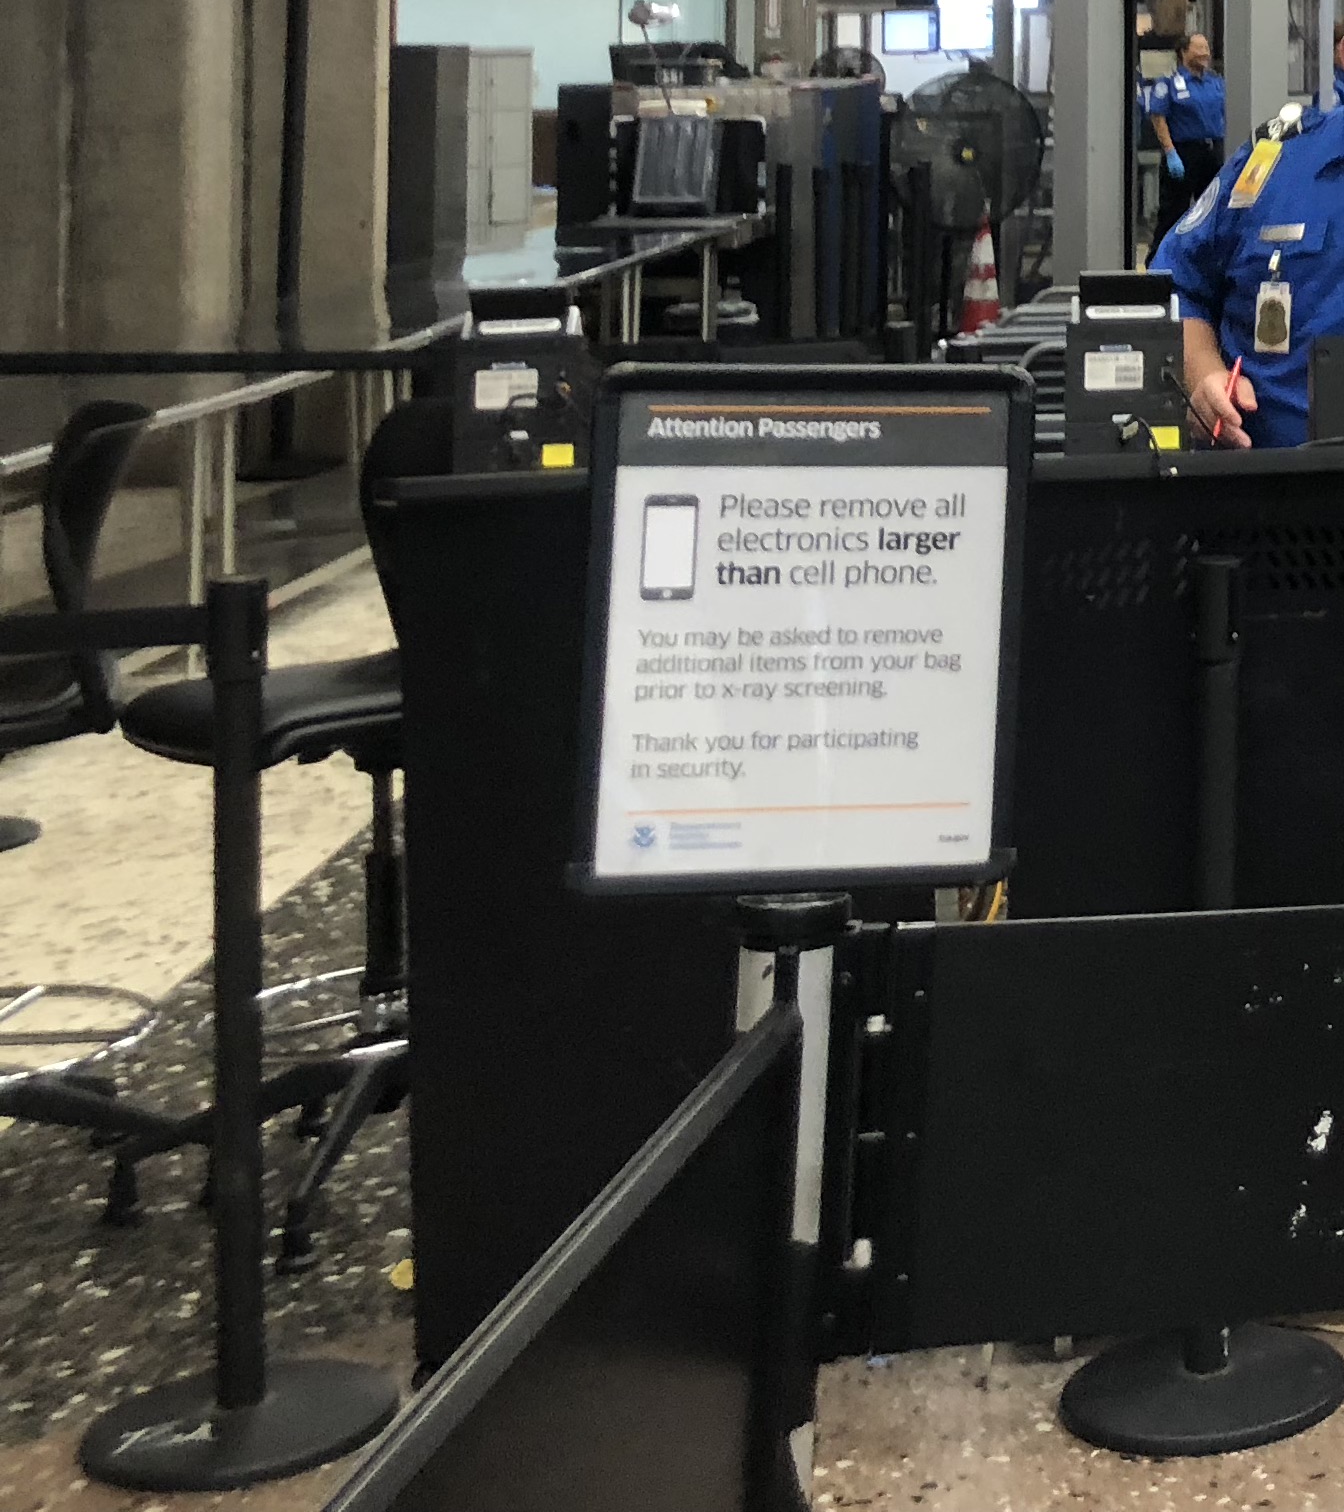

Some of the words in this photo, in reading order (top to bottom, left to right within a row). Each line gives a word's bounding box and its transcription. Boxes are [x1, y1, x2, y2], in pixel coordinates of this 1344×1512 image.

[647, 416, 753, 439] Attention
[757, 418, 881, 442] Passengers
[719, 493, 809, 519] Please
[818, 496, 926, 519] remove
[935, 492, 966, 518] all
[717, 526, 869, 552] electronics
[877, 526, 961, 552] larger
[717, 561, 781, 586] than
[789, 560, 836, 585] cell
[844, 561, 938, 588] phone.
[637, 628, 680, 648] You
[684, 633, 731, 650] may
[737, 628, 762, 647] be
[768, 626, 832, 646] asked
[837, 628, 858, 646] to
[863, 630, 943, 645] remove
[635, 652, 743, 673] additional
[749, 651, 807, 672] items
[812, 651, 864, 671] from
[869, 654, 918, 675] your
[923, 651, 962, 672] bag
[634, 680, 687, 702] prior
[693, 680, 715, 699] to
[721, 682, 777, 701] x-ray
[783, 678, 888, 701] screening.
[632, 732, 699, 753] Thank
[704, 737, 745, 756] you
[750, 731, 781, 750] for
[787, 727, 919, 754] participating
[631, 765, 650, 780] in
[656, 758, 746, 782] security.
